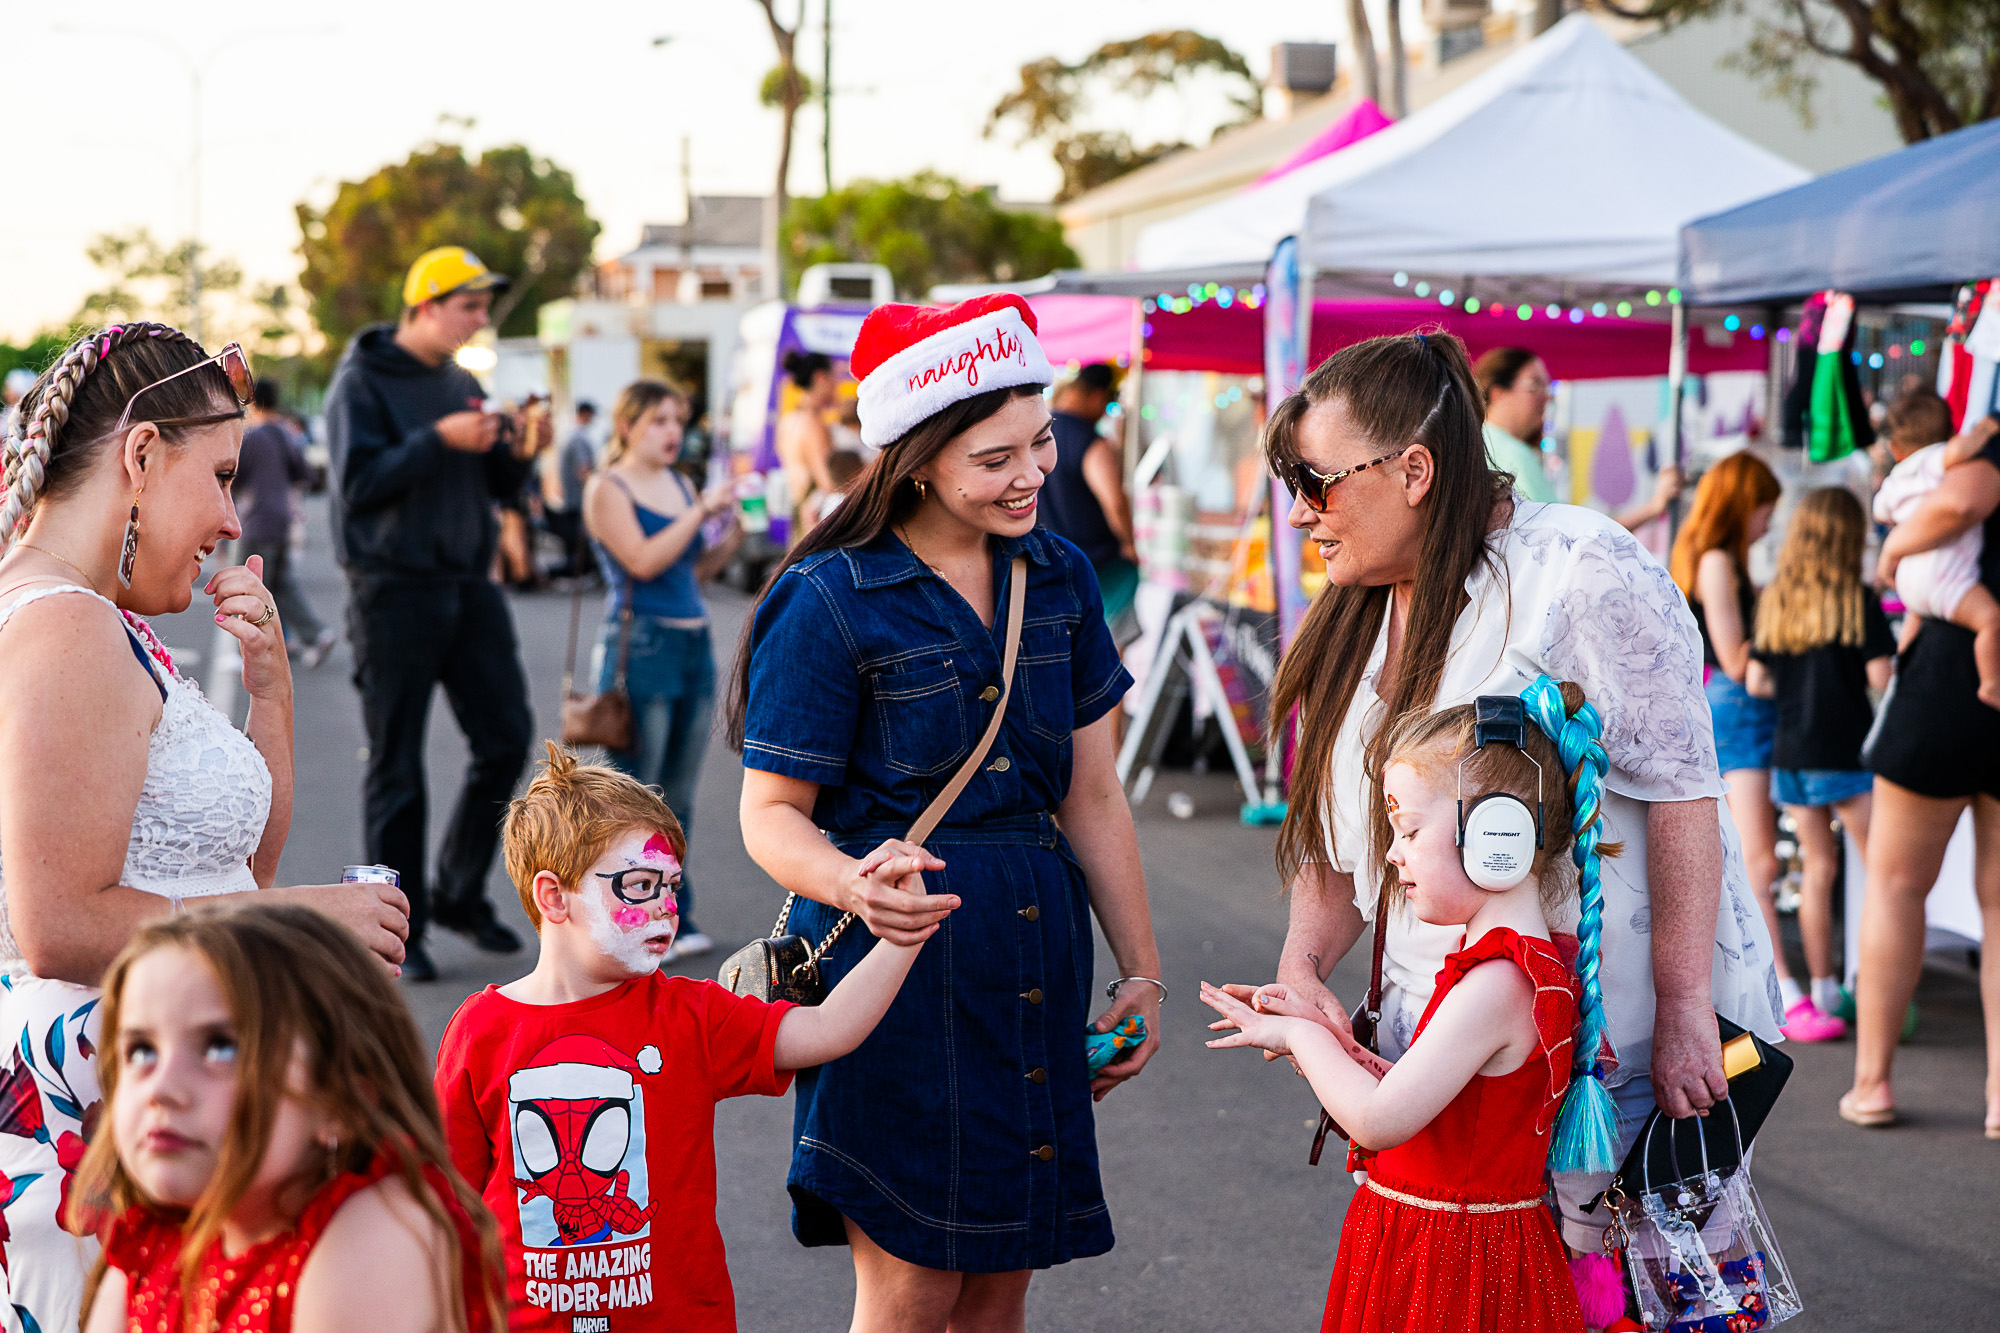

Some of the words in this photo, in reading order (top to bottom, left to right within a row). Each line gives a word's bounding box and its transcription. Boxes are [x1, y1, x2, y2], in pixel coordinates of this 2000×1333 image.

[908, 328, 1026, 392] naughty
[522, 1252, 558, 1280] THE
[564, 1242, 651, 1280] AMAZING
[525, 1272, 653, 1312] SPIDER-MAN
[572, 1316, 610, 1333] MARVEL
